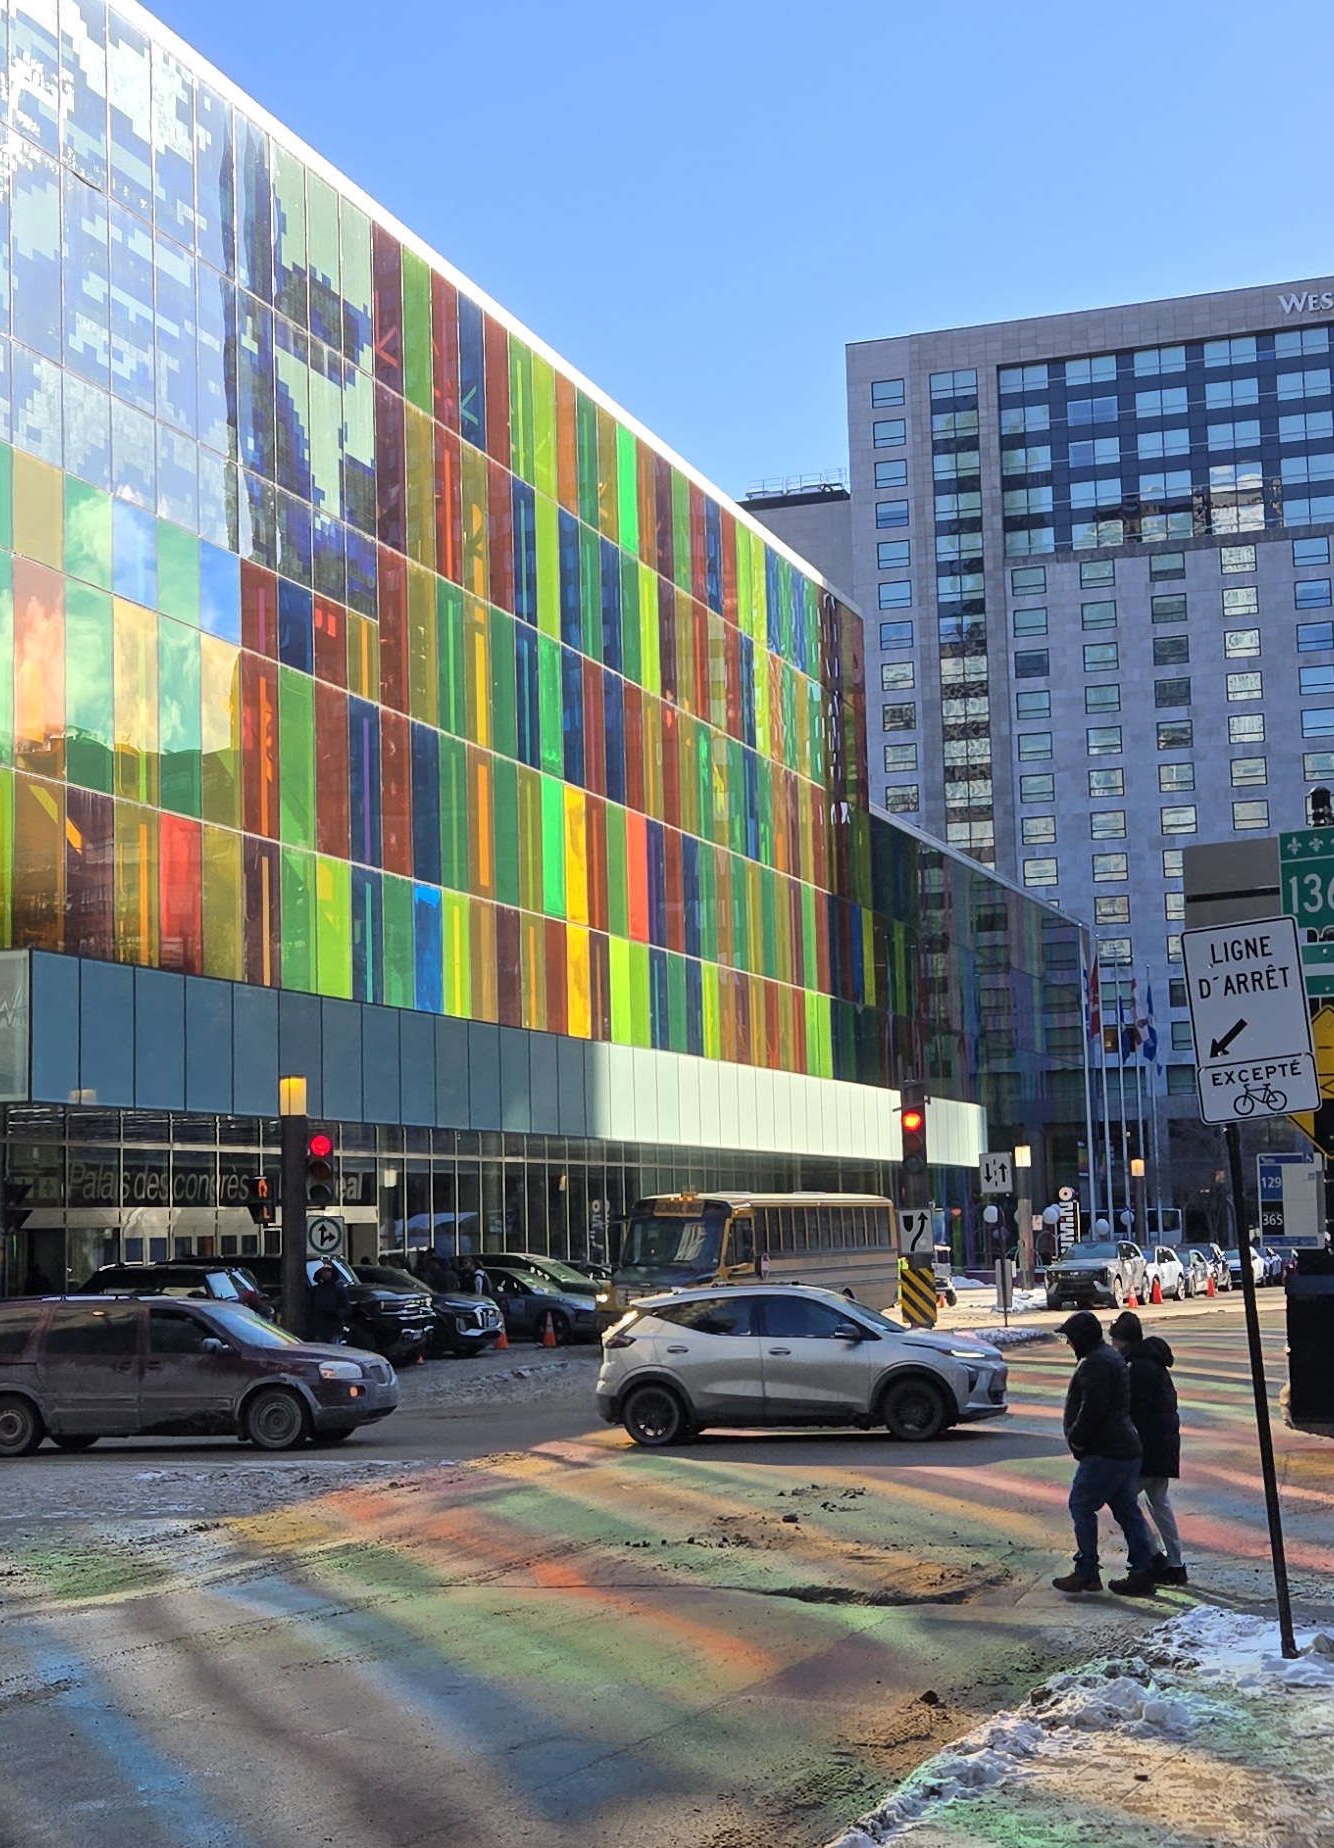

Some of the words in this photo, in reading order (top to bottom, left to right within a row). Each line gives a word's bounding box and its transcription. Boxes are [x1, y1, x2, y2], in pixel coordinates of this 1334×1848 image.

[1210, 935, 1273, 965] LIGNE
[1198, 963, 1290, 1000] D'ARRÊT
[1211, 1058, 1302, 1087] EXCEPTÉ
[133, 1164, 169, 1200] des
[1260, 1176, 1282, 1189] 129
[1262, 1213, 1284, 1226] 365
